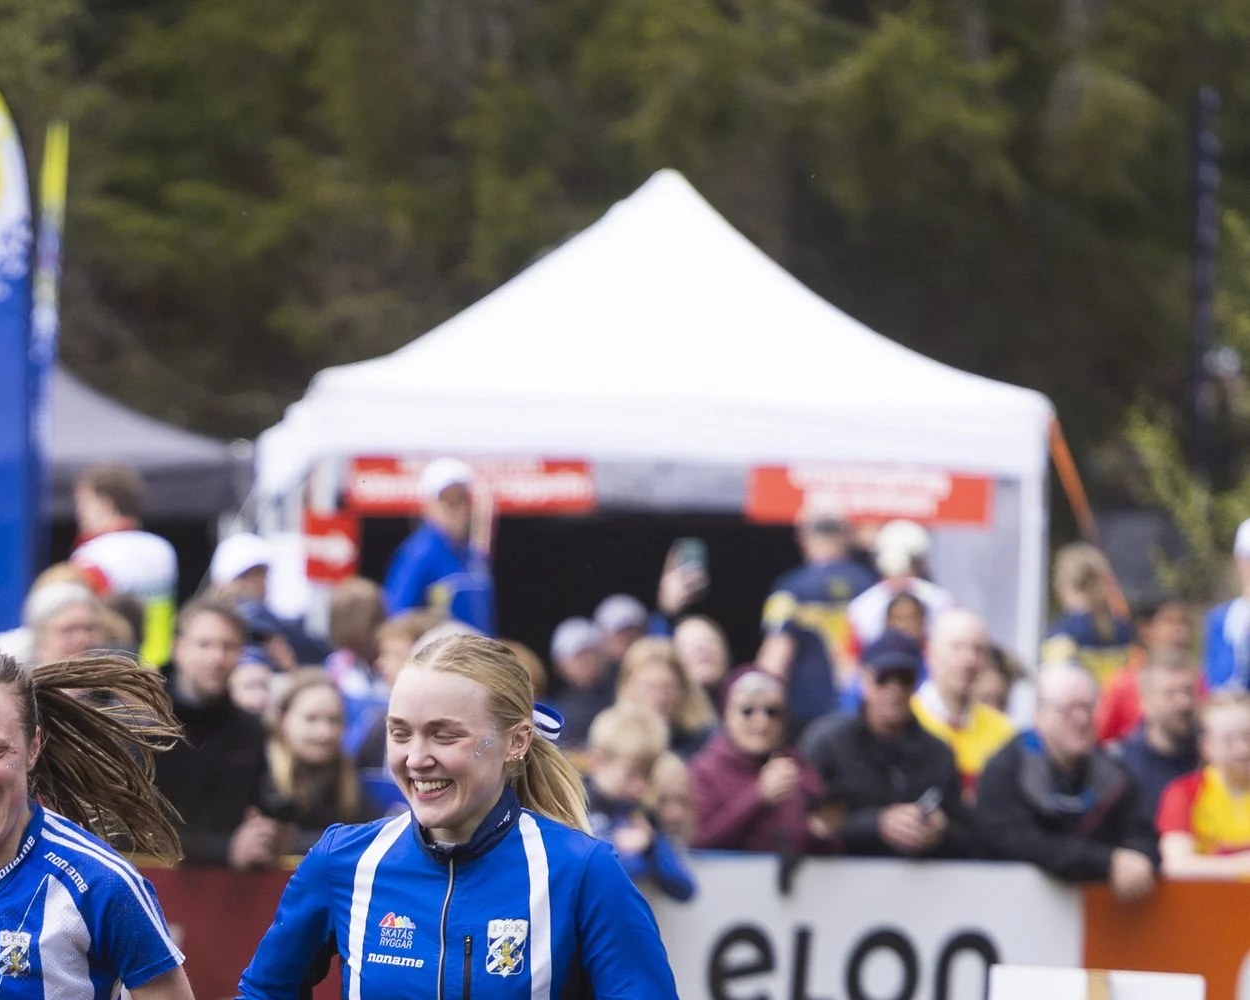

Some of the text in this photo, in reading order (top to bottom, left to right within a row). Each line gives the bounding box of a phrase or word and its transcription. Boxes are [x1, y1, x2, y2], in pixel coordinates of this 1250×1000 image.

[43, 852, 89, 893] noname
[380, 926, 413, 940] SKATÅS
[379, 938, 413, 949] RYGGAR
[367, 953, 424, 968] noname
